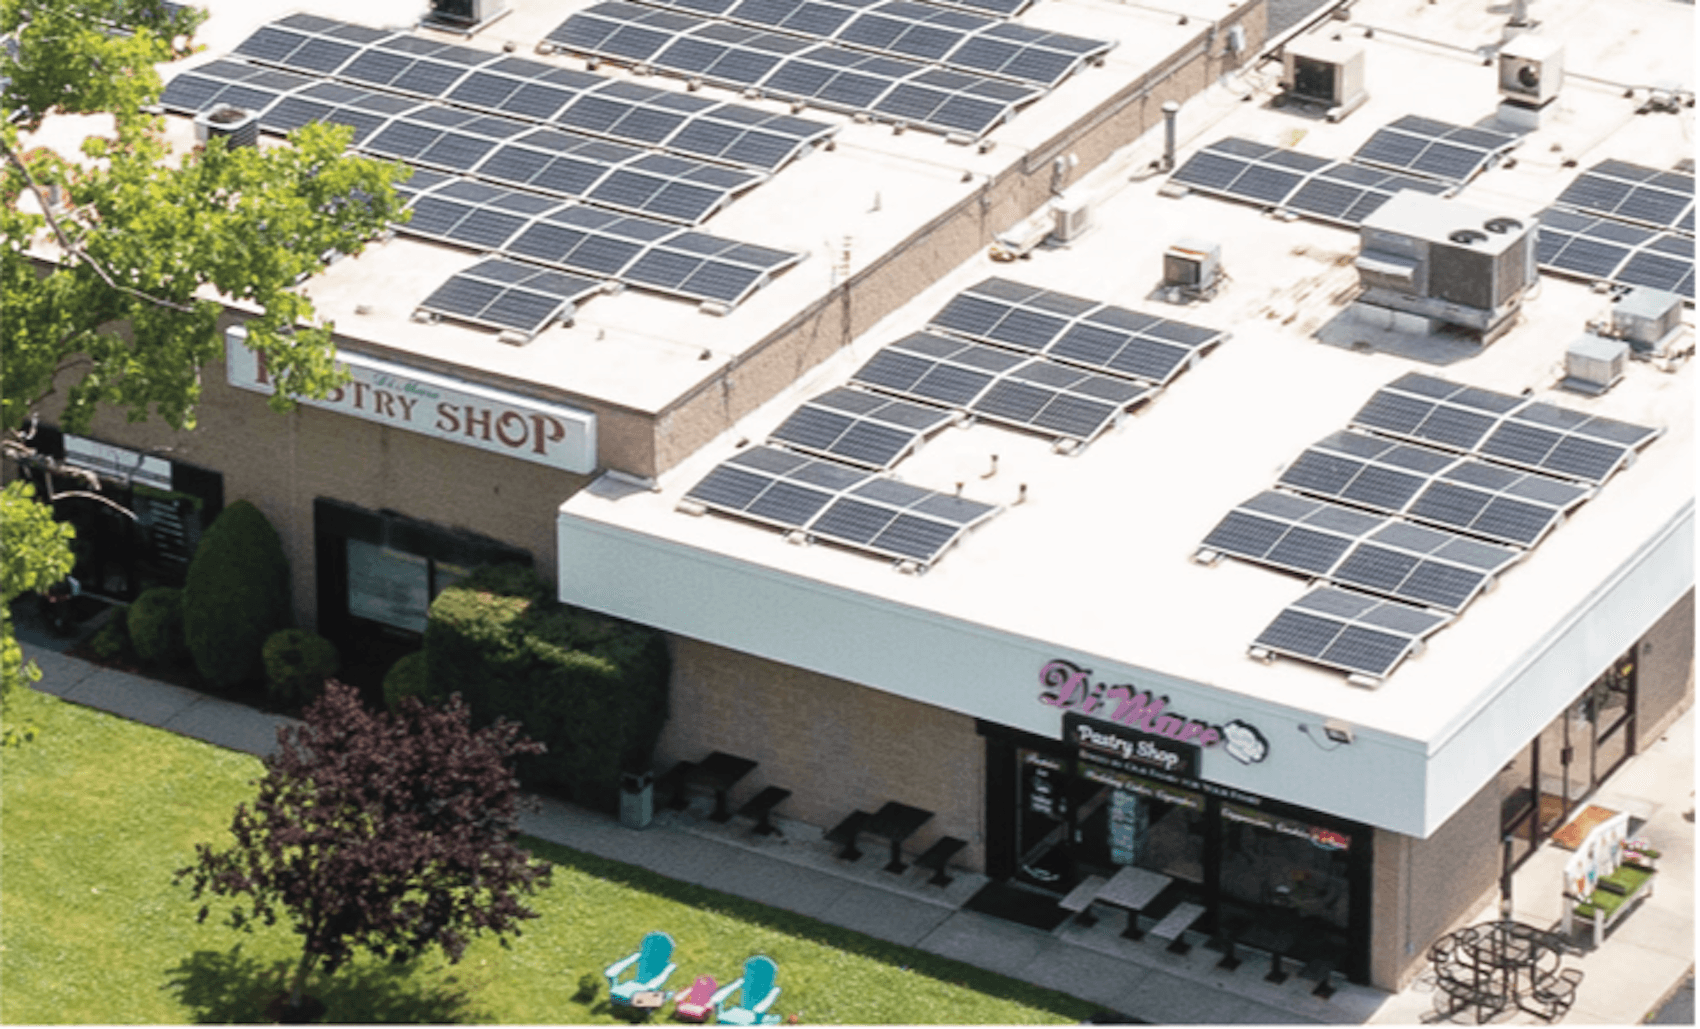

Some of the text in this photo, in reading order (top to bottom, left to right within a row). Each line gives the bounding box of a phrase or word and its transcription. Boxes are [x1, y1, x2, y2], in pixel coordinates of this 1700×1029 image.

[435, 402, 565, 454] SHOP
[1077, 724, 1179, 771] Pastry Shop
